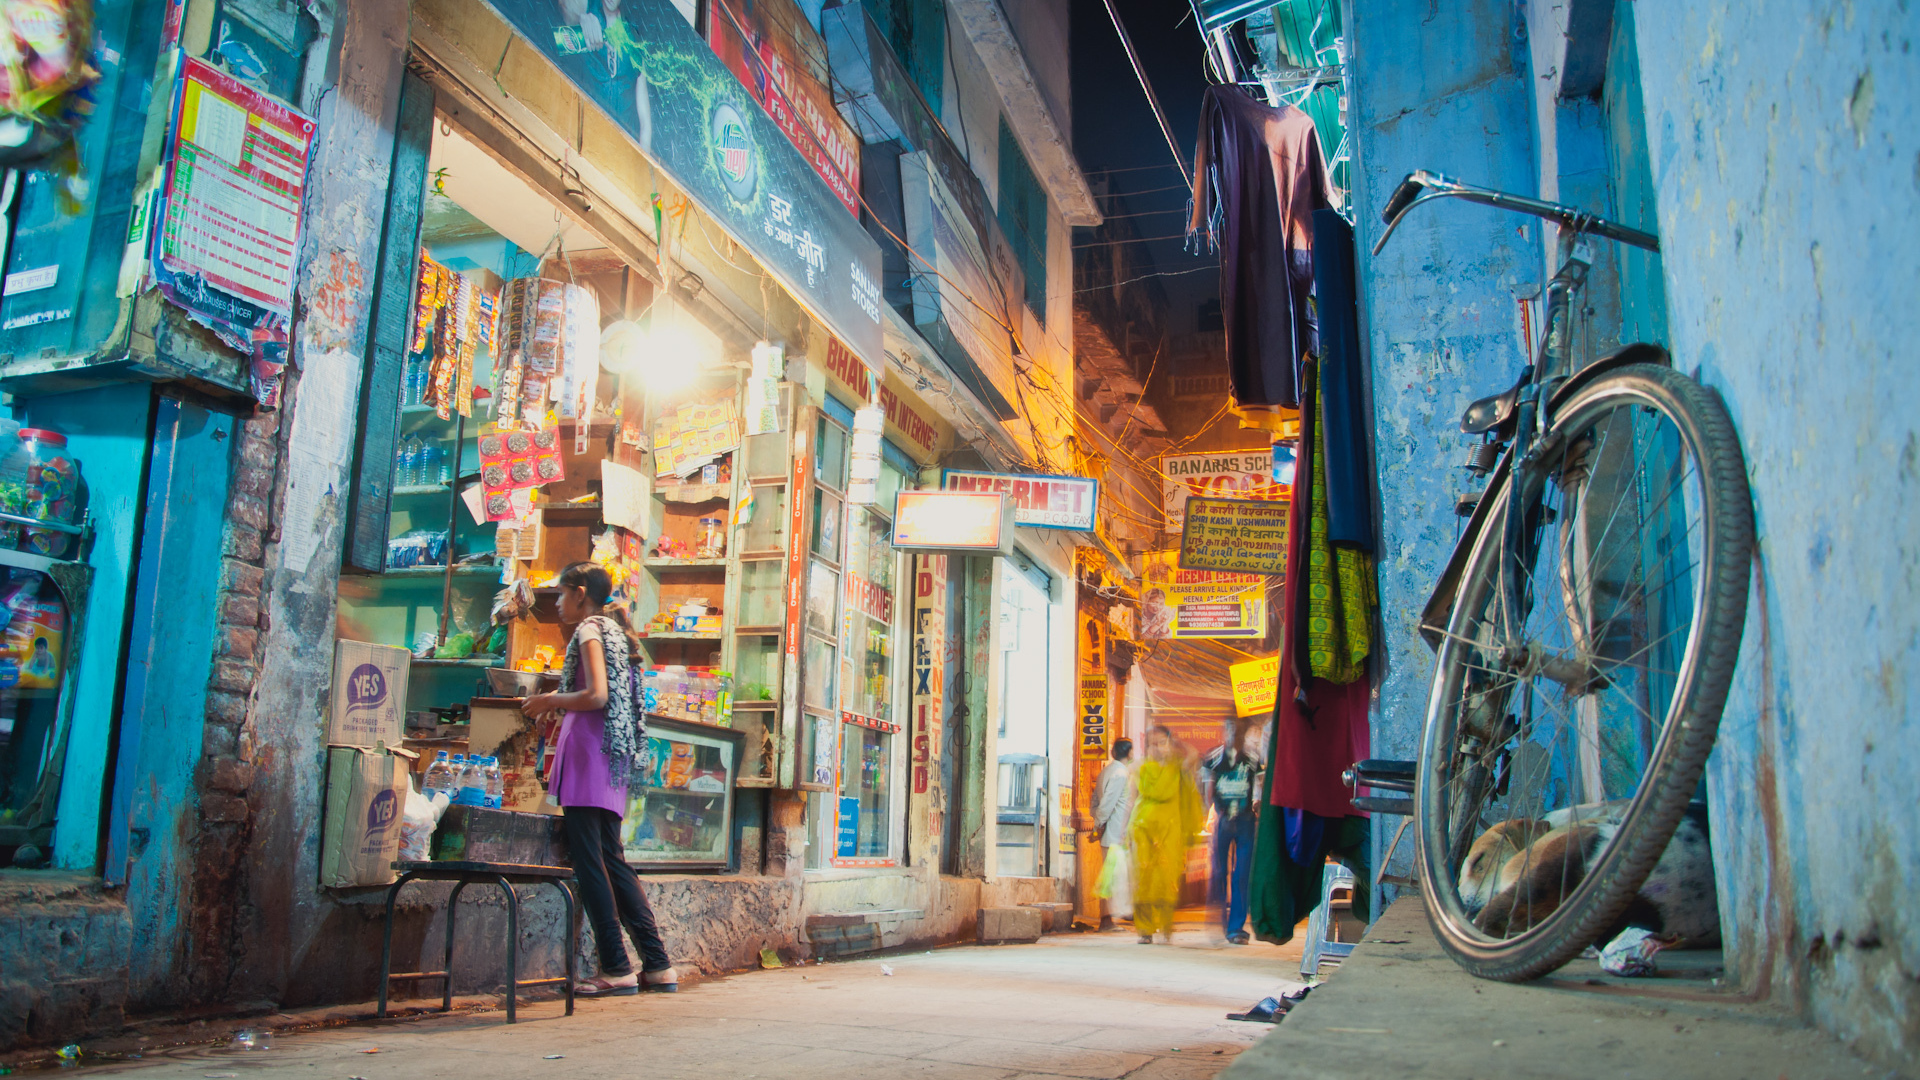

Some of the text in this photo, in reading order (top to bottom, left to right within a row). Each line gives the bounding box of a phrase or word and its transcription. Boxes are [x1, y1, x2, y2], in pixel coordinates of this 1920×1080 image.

[771, 52, 857, 182] EVEREADY
[771, 99, 856, 208] FULL FULL MASALA
[768, 193, 793, 227] डर
[764, 217, 825, 274] के आगे जीत
[805, 264, 816, 289] है
[850, 261, 881, 304] SANJAY
[204, 293, 227, 311] CAUSES
[851, 286, 881, 325] STORES
[826, 337, 939, 453] BHAVSH INTERNET
[1169, 454, 1273, 475] BANARAS SCH
[1165, 484, 1180, 503] of
[1072, 515, 1092, 526] FAX
[1190, 514, 1208, 524] SHRI
[1210, 516, 1233, 526] KASHI
[1236, 517, 1286, 527] VISHWANATH
[1195, 502, 1207, 515] श्री
[1209, 504, 1235, 515] काशी
[1175, 569, 1212, 584] HEENA
[1216, 595, 1240, 603] CENTRE
[353, 674, 380, 700] YES
[1081, 689, 1106, 699] SCHOOL
[343, 724, 367, 733] DRINKING
[352, 717, 379, 726] PACKAGED
[1082, 704, 1105, 746] YOGA
[913, 704, 930, 794] ISD
[374, 800, 395, 825] YES
